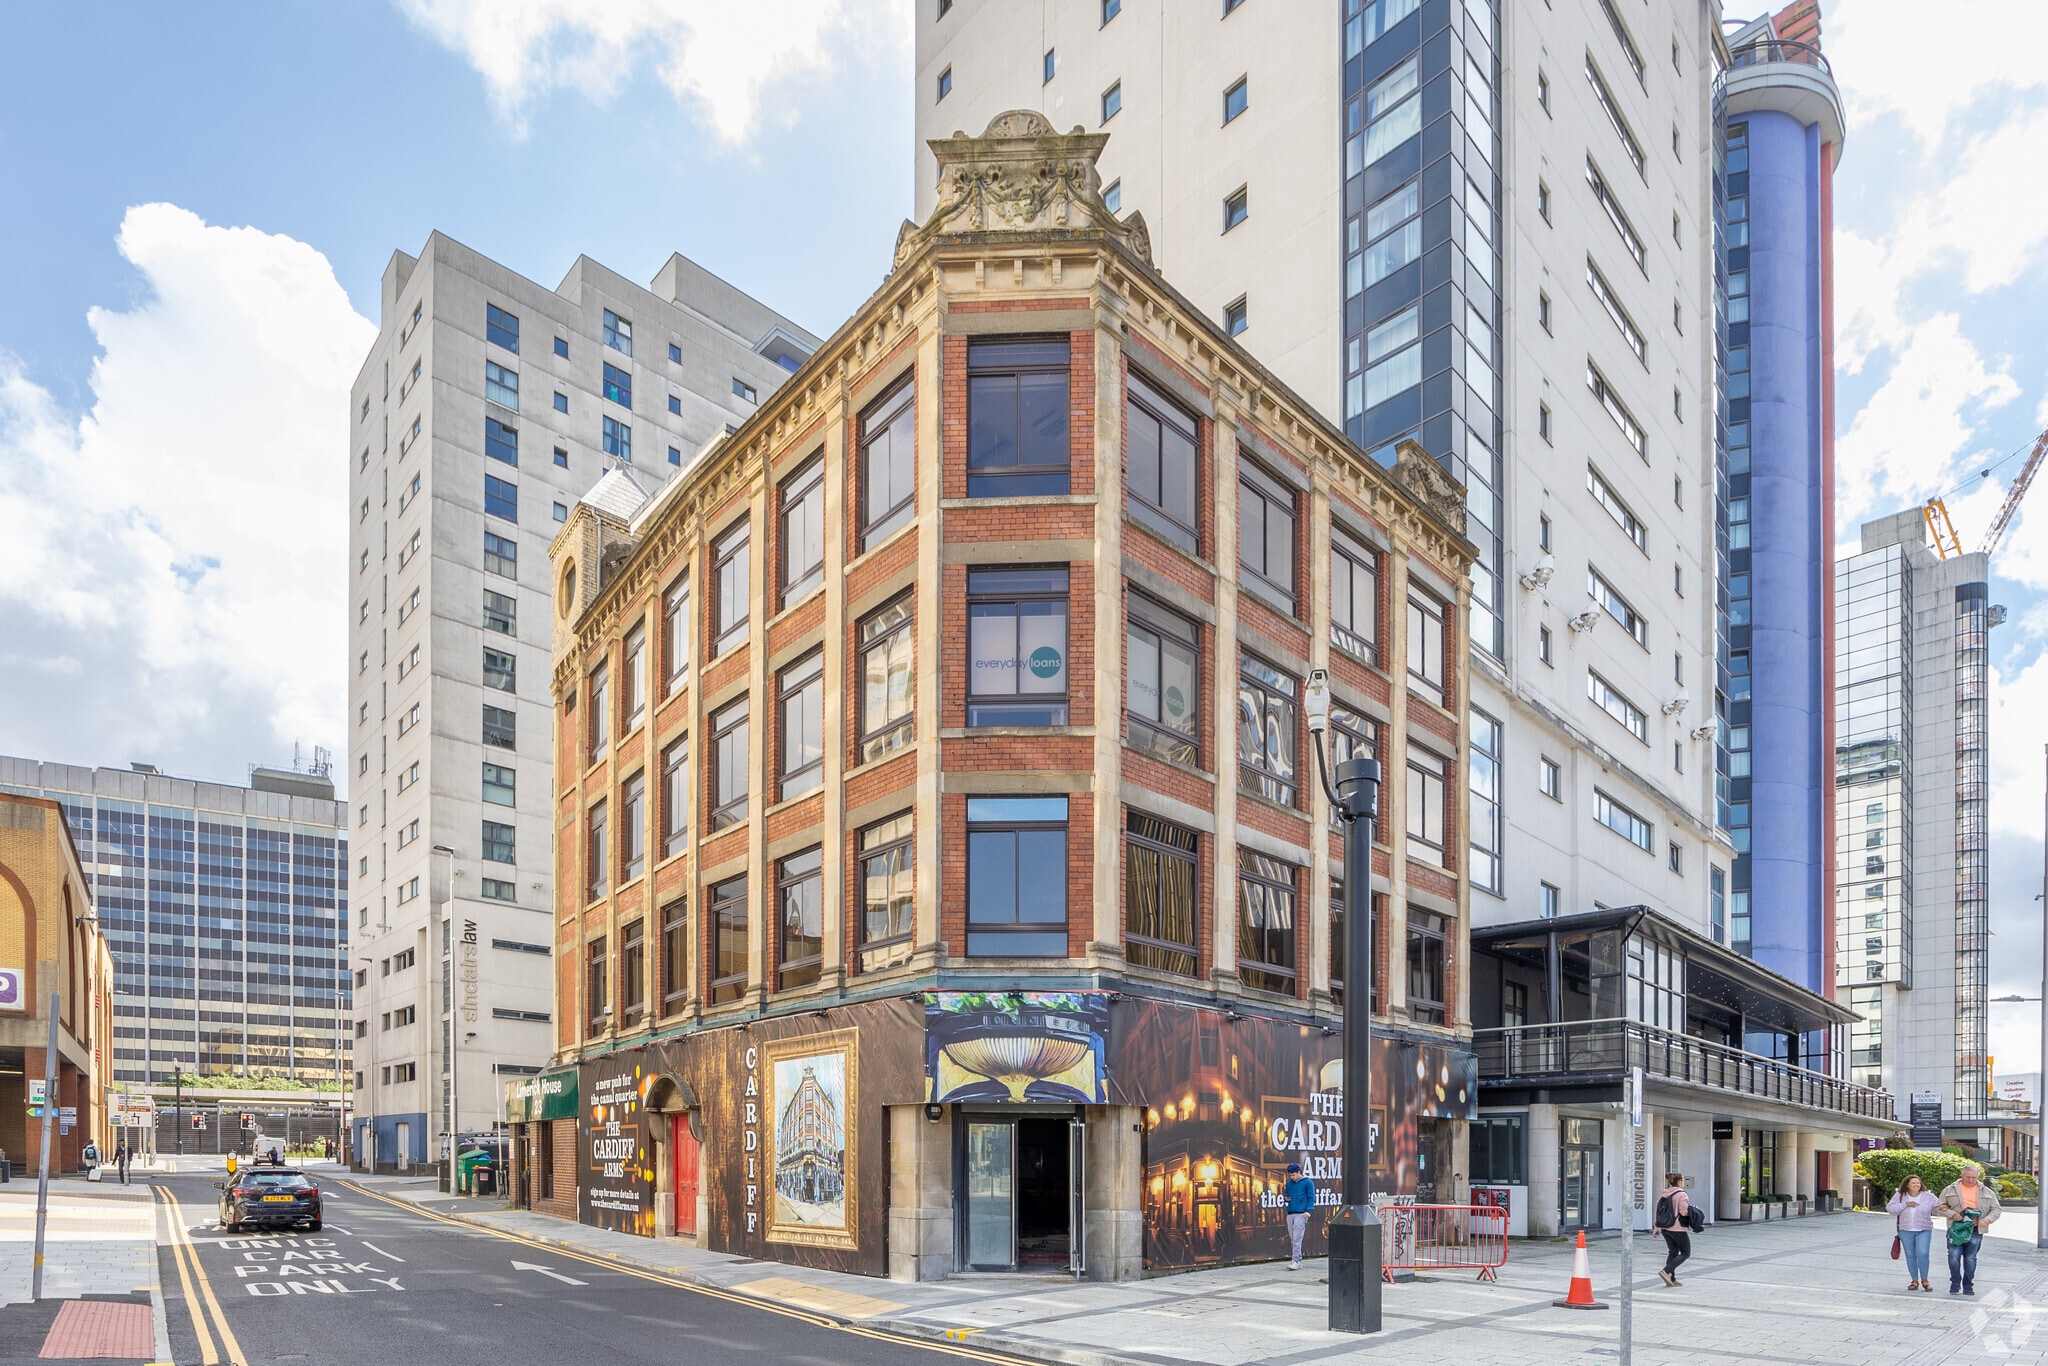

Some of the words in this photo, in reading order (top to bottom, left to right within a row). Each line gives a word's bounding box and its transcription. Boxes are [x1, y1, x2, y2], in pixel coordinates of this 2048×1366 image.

[975, 657, 1029, 670] everyday
[1030, 657, 1061, 668] loans
[1166, 692, 1185, 710] loans
[516, 1077, 541, 1098] Limerick
[541, 1078, 562, 1095] House
[599, 1079, 611, 1090] new
[611, 1074, 622, 1091] pub
[622, 1073, 632, 1086] for
[590, 1093, 600, 1106] the
[599, 1090, 615, 1105] canal
[614, 1089, 638, 1106] quarter
[1309, 1092, 1344, 1117] THE
[534, 1099, 543, 1115] 23
[605, 1121, 621, 1137] THE
[1271, 1117, 1379, 1152] CARDF
[593, 1138, 635, 1159] CARDIFF
[745, 1047, 757, 1233] CARDIFF
[603, 1162, 624, 1178] ARMS
[1302, 1156, 1343, 1180] ARM
[1633, 1133, 1646, 1210] sinclairslaw
[243, 1250, 346, 1262] CAR
[233, 1262, 387, 1278] PARK
[244, 1277, 407, 1297] ONLY
